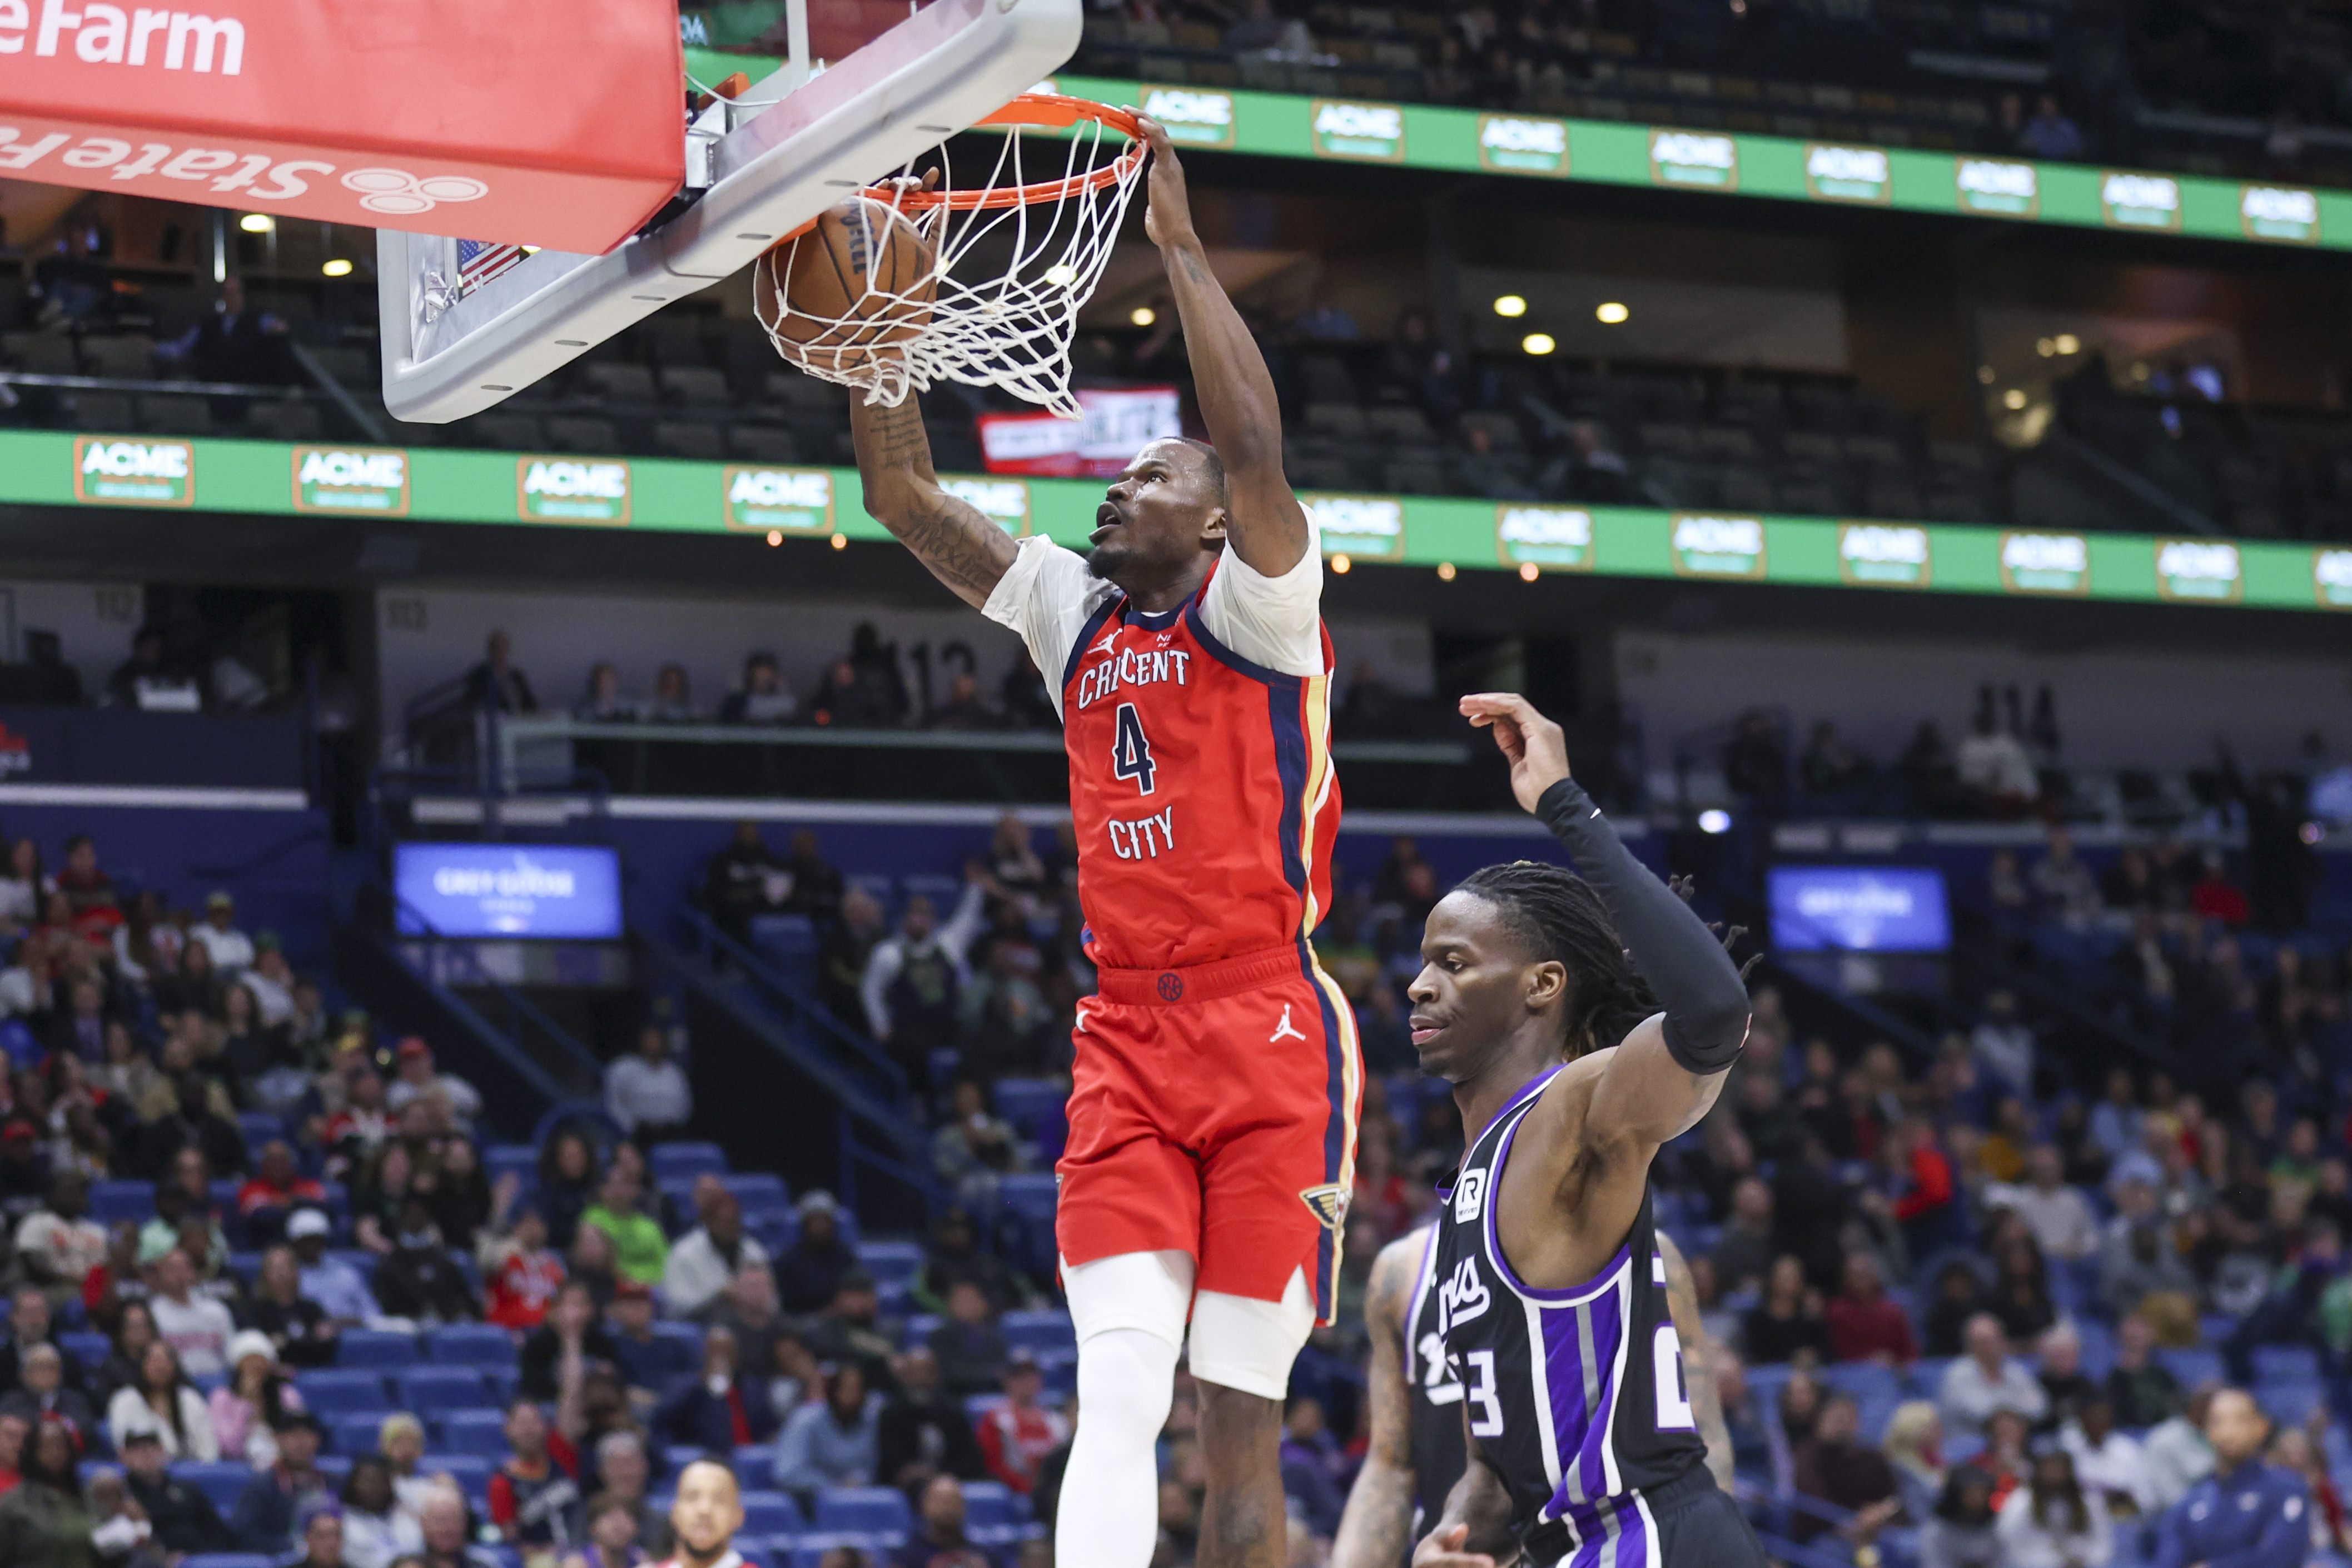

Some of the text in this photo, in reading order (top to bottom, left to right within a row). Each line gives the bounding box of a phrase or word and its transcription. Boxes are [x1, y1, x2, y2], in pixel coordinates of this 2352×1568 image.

[82, 442, 188, 478] ACME
[299, 451, 404, 487] ACME
[524, 461, 626, 497] ACME
[729, 471, 829, 507] ACME
[1078, 646, 1190, 710] CRCENT
[1112, 702, 1157, 797] 4
[1108, 805, 1174, 860] CITY
[1461, 1177, 1478, 1203] R
